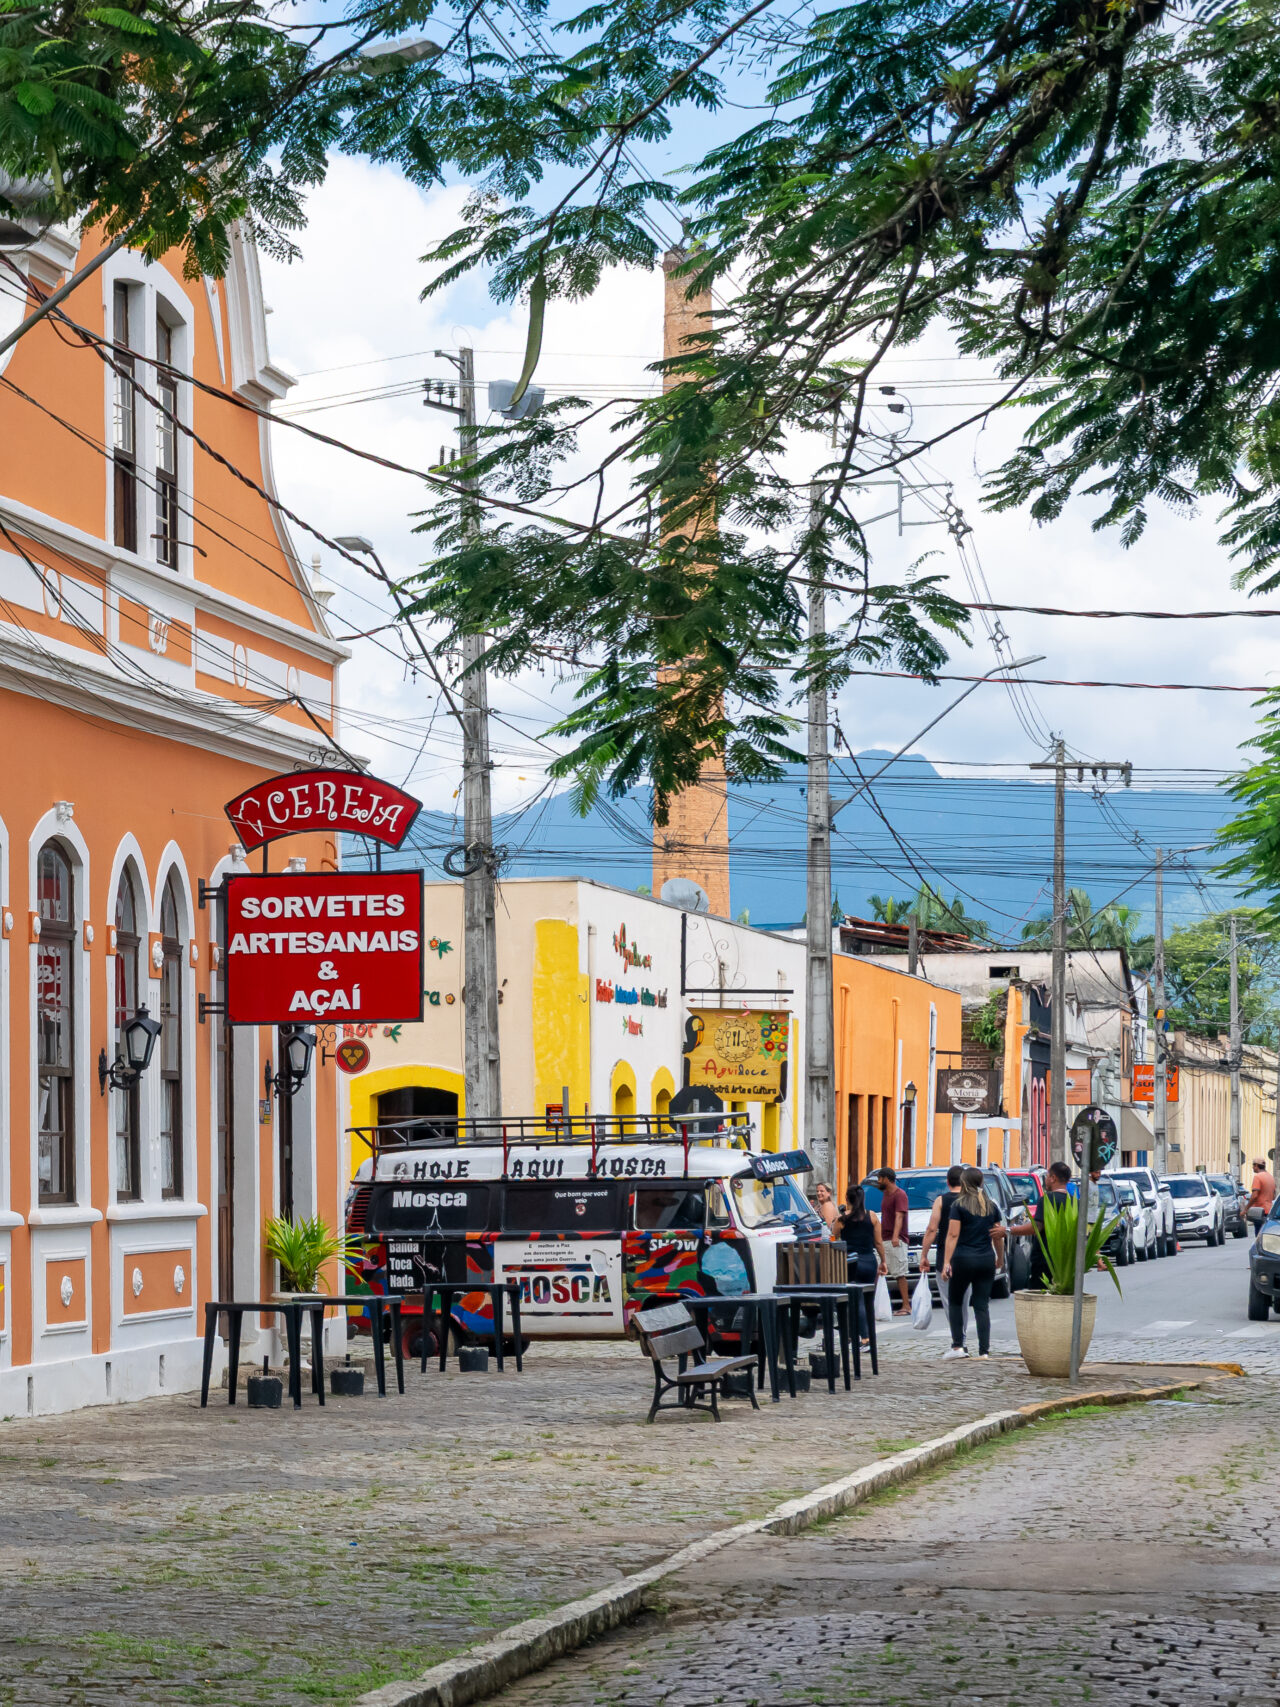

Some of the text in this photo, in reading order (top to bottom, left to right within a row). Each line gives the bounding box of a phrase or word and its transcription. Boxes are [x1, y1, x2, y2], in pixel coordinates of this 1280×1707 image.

[267, 781, 404, 832] CEREJA
[241, 894, 405, 918] SORVETES
[228, 930, 418, 954] ARTESANAIS
[318, 961, 339, 980] &
[288, 983, 361, 1016] AÇAÍ
[343, 1023, 377, 1038] mor
[731, 1085, 746, 1094] Arte
[753, 1086, 777, 1095] Cultura
[414, 1157, 666, 1180] HOJE AQUI MOSCA
[762, 1160, 789, 1174] Mosca
[392, 1190, 468, 1208] Mosca
[389, 1239, 419, 1253] Banda
[649, 1238, 700, 1252] SHOW
[389, 1258, 413, 1270] Toca
[390, 1275, 414, 1287] Nada
[506, 1274, 612, 1304] MOSCA
